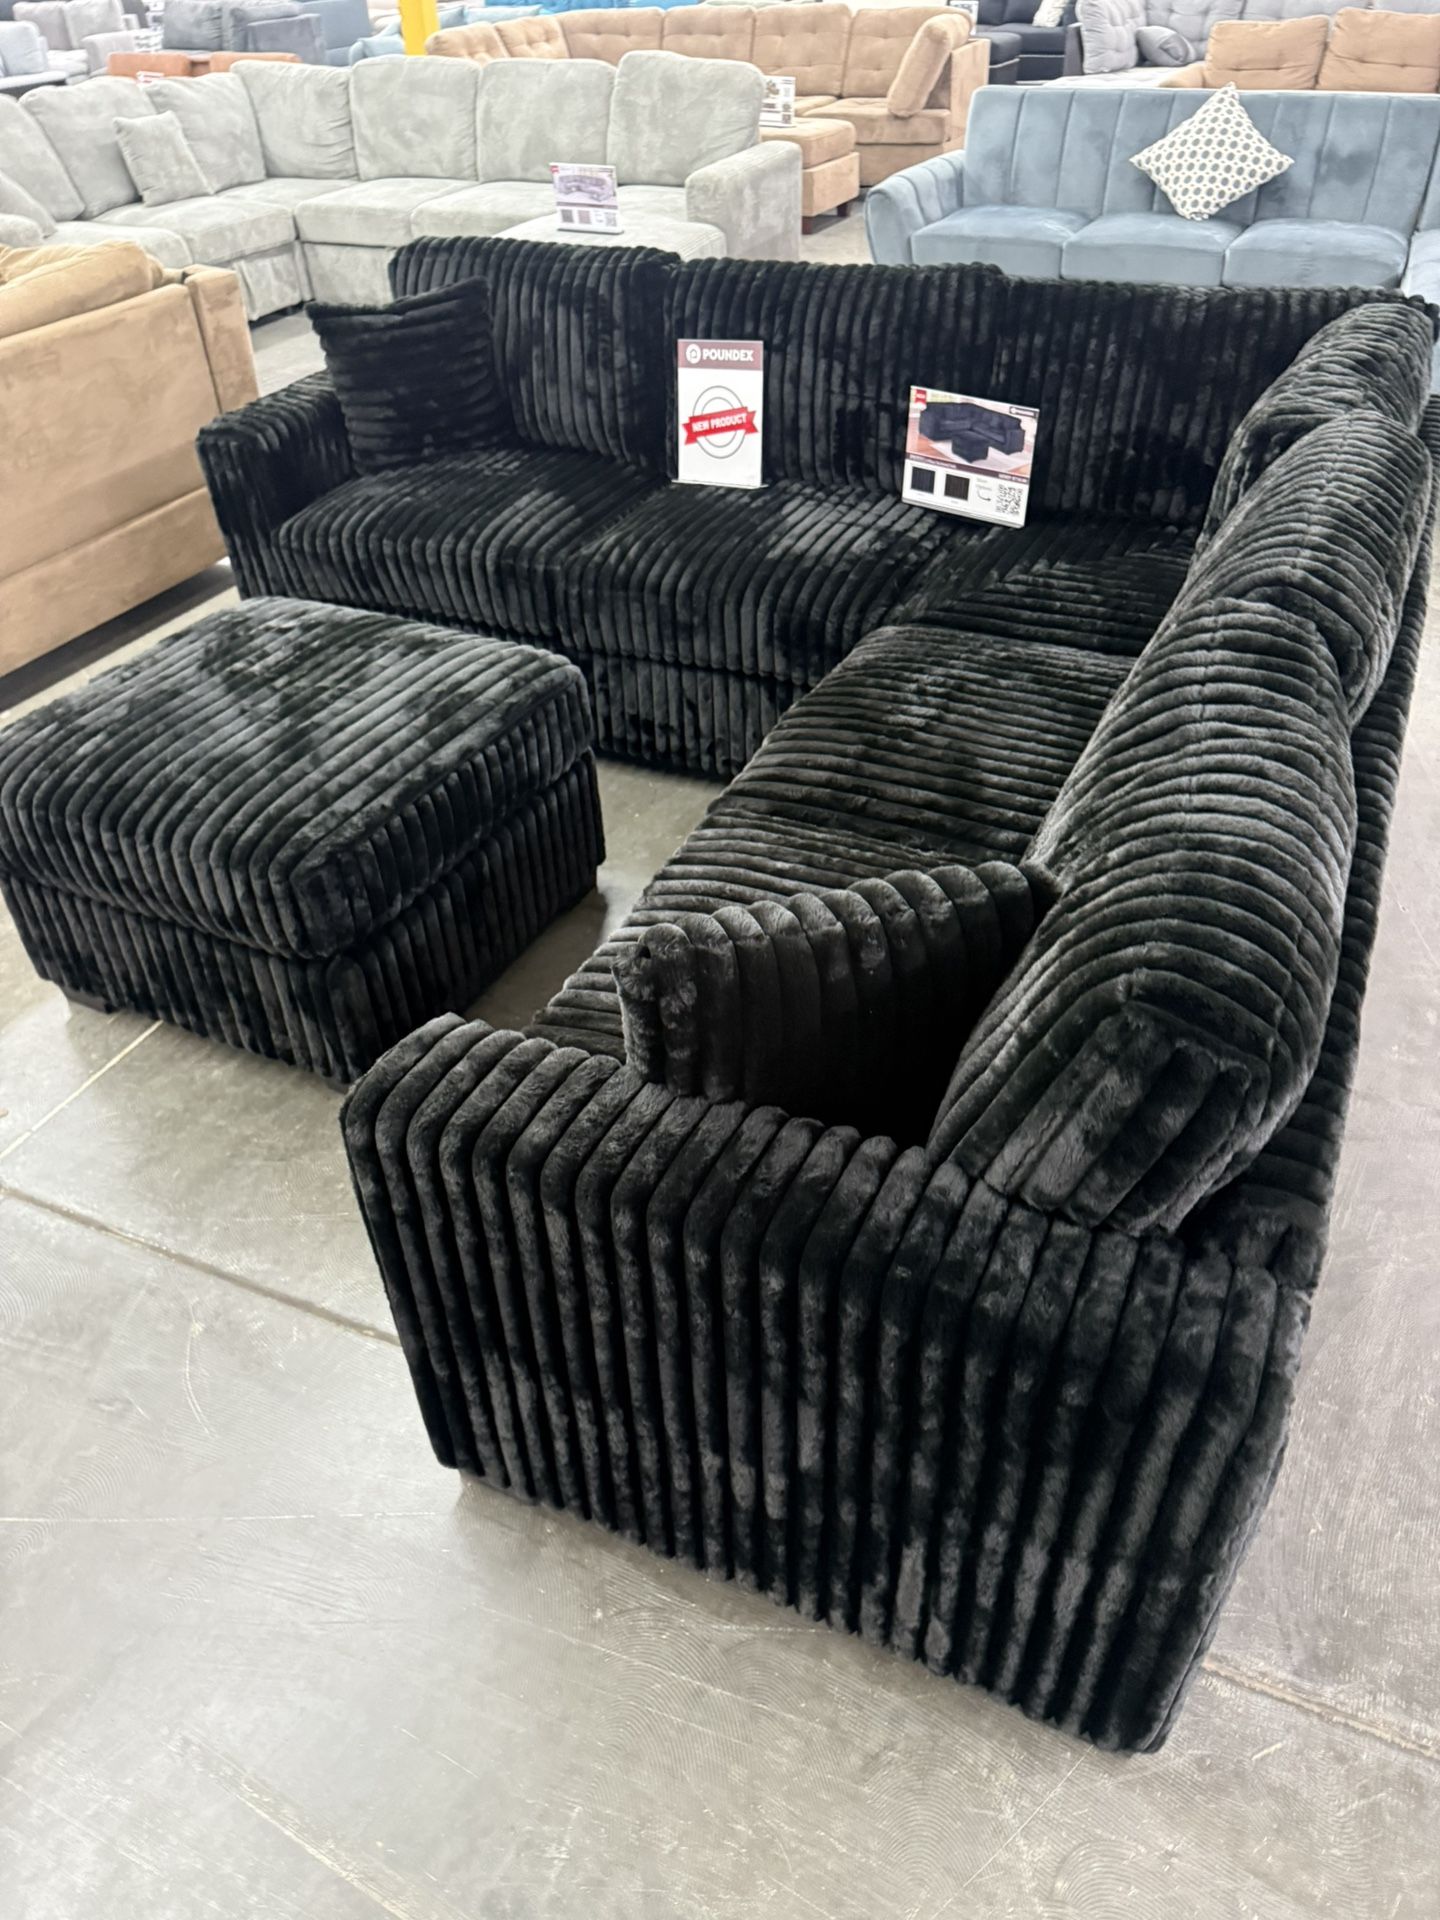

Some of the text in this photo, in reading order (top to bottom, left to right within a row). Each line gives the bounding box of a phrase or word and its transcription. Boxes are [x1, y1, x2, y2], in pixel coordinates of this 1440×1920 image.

[702, 349, 754, 361] POUNDEX
[692, 413, 746, 432] NEW PRODUCT
